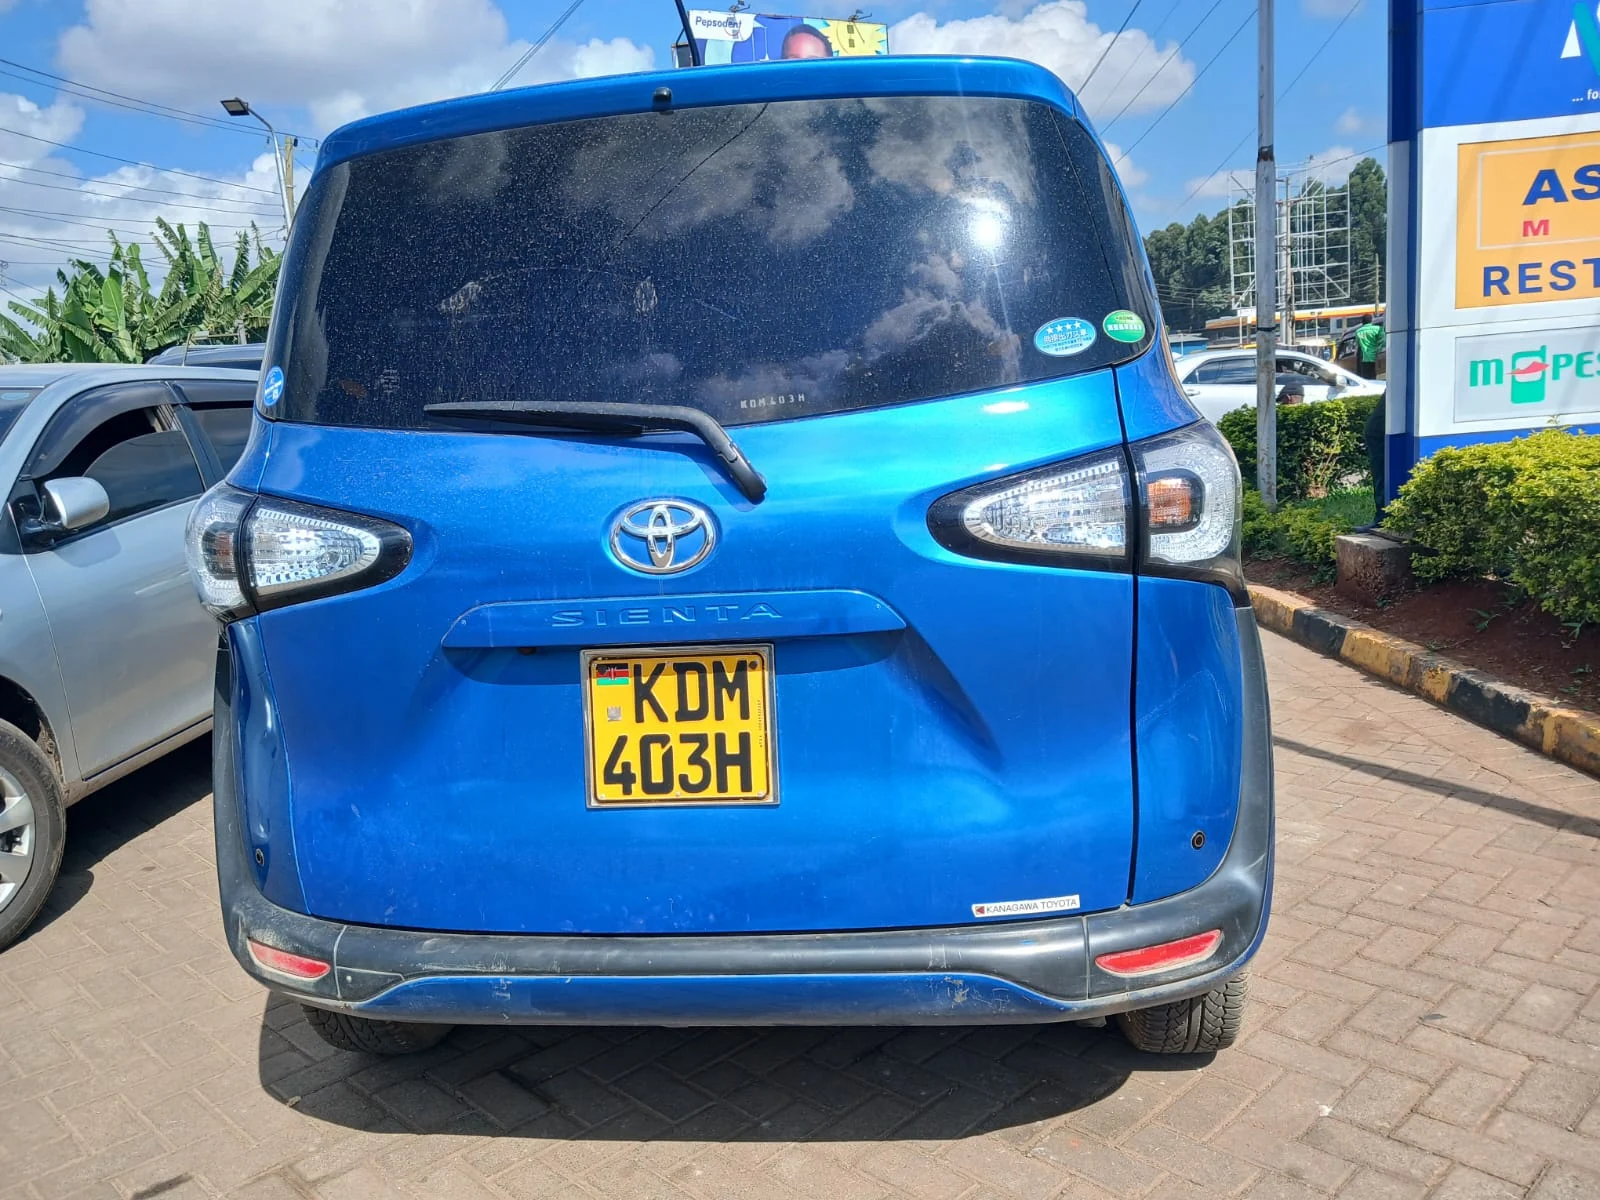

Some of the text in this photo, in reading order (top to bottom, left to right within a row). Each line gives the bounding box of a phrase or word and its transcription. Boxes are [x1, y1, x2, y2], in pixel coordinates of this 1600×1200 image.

[695, 15, 742, 28] Pepsodent
[1587, 88, 1600, 101] fo
[1522, 219, 1550, 237] M
[1483, 257, 1600, 297] REST
[551, 602, 783, 627] SIENTA
[633, 660, 750, 723] KDM
[603, 731, 753, 795] 403H
[986, 898, 1077, 914] KANAGAWA TOYOTA
